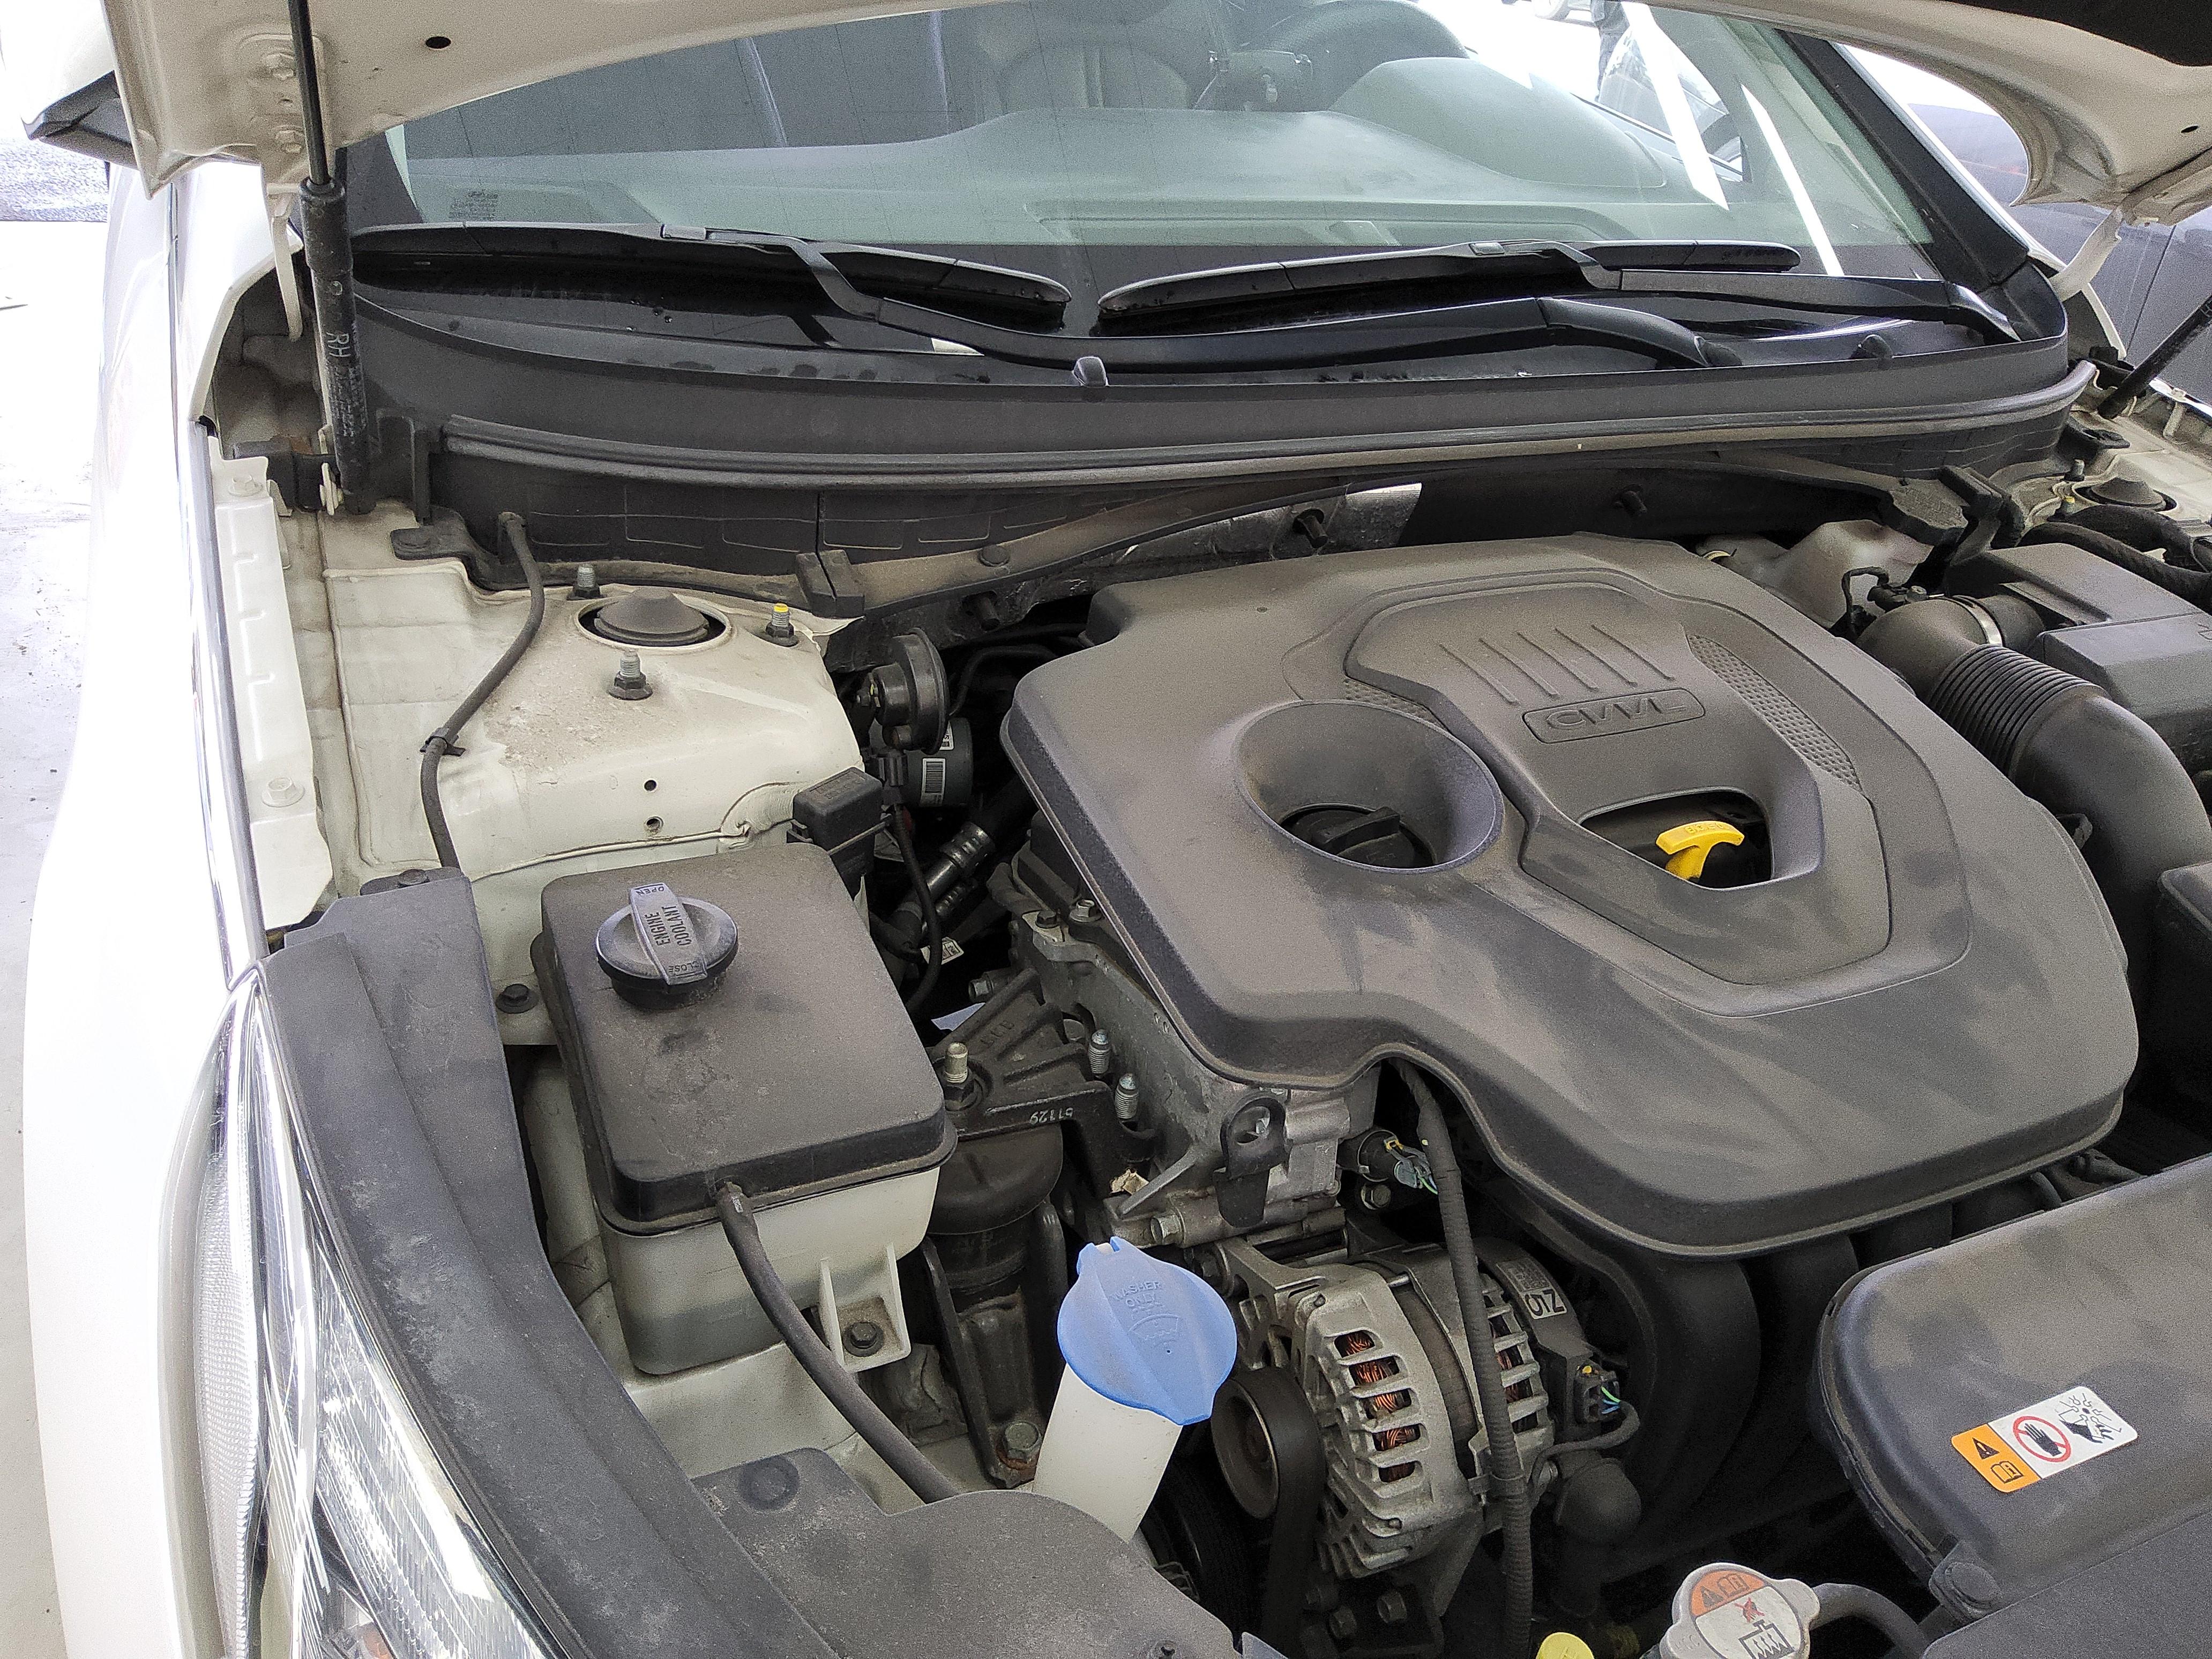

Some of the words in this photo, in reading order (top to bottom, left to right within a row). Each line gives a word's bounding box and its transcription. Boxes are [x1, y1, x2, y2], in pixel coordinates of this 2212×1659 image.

[325, 332, 352, 357] RH
[636, 886, 665, 895] OPEN
[645, 911, 671, 946] ENGINE
[661, 906, 692, 946] COOLANT
[669, 961, 701, 973] CLOSE
